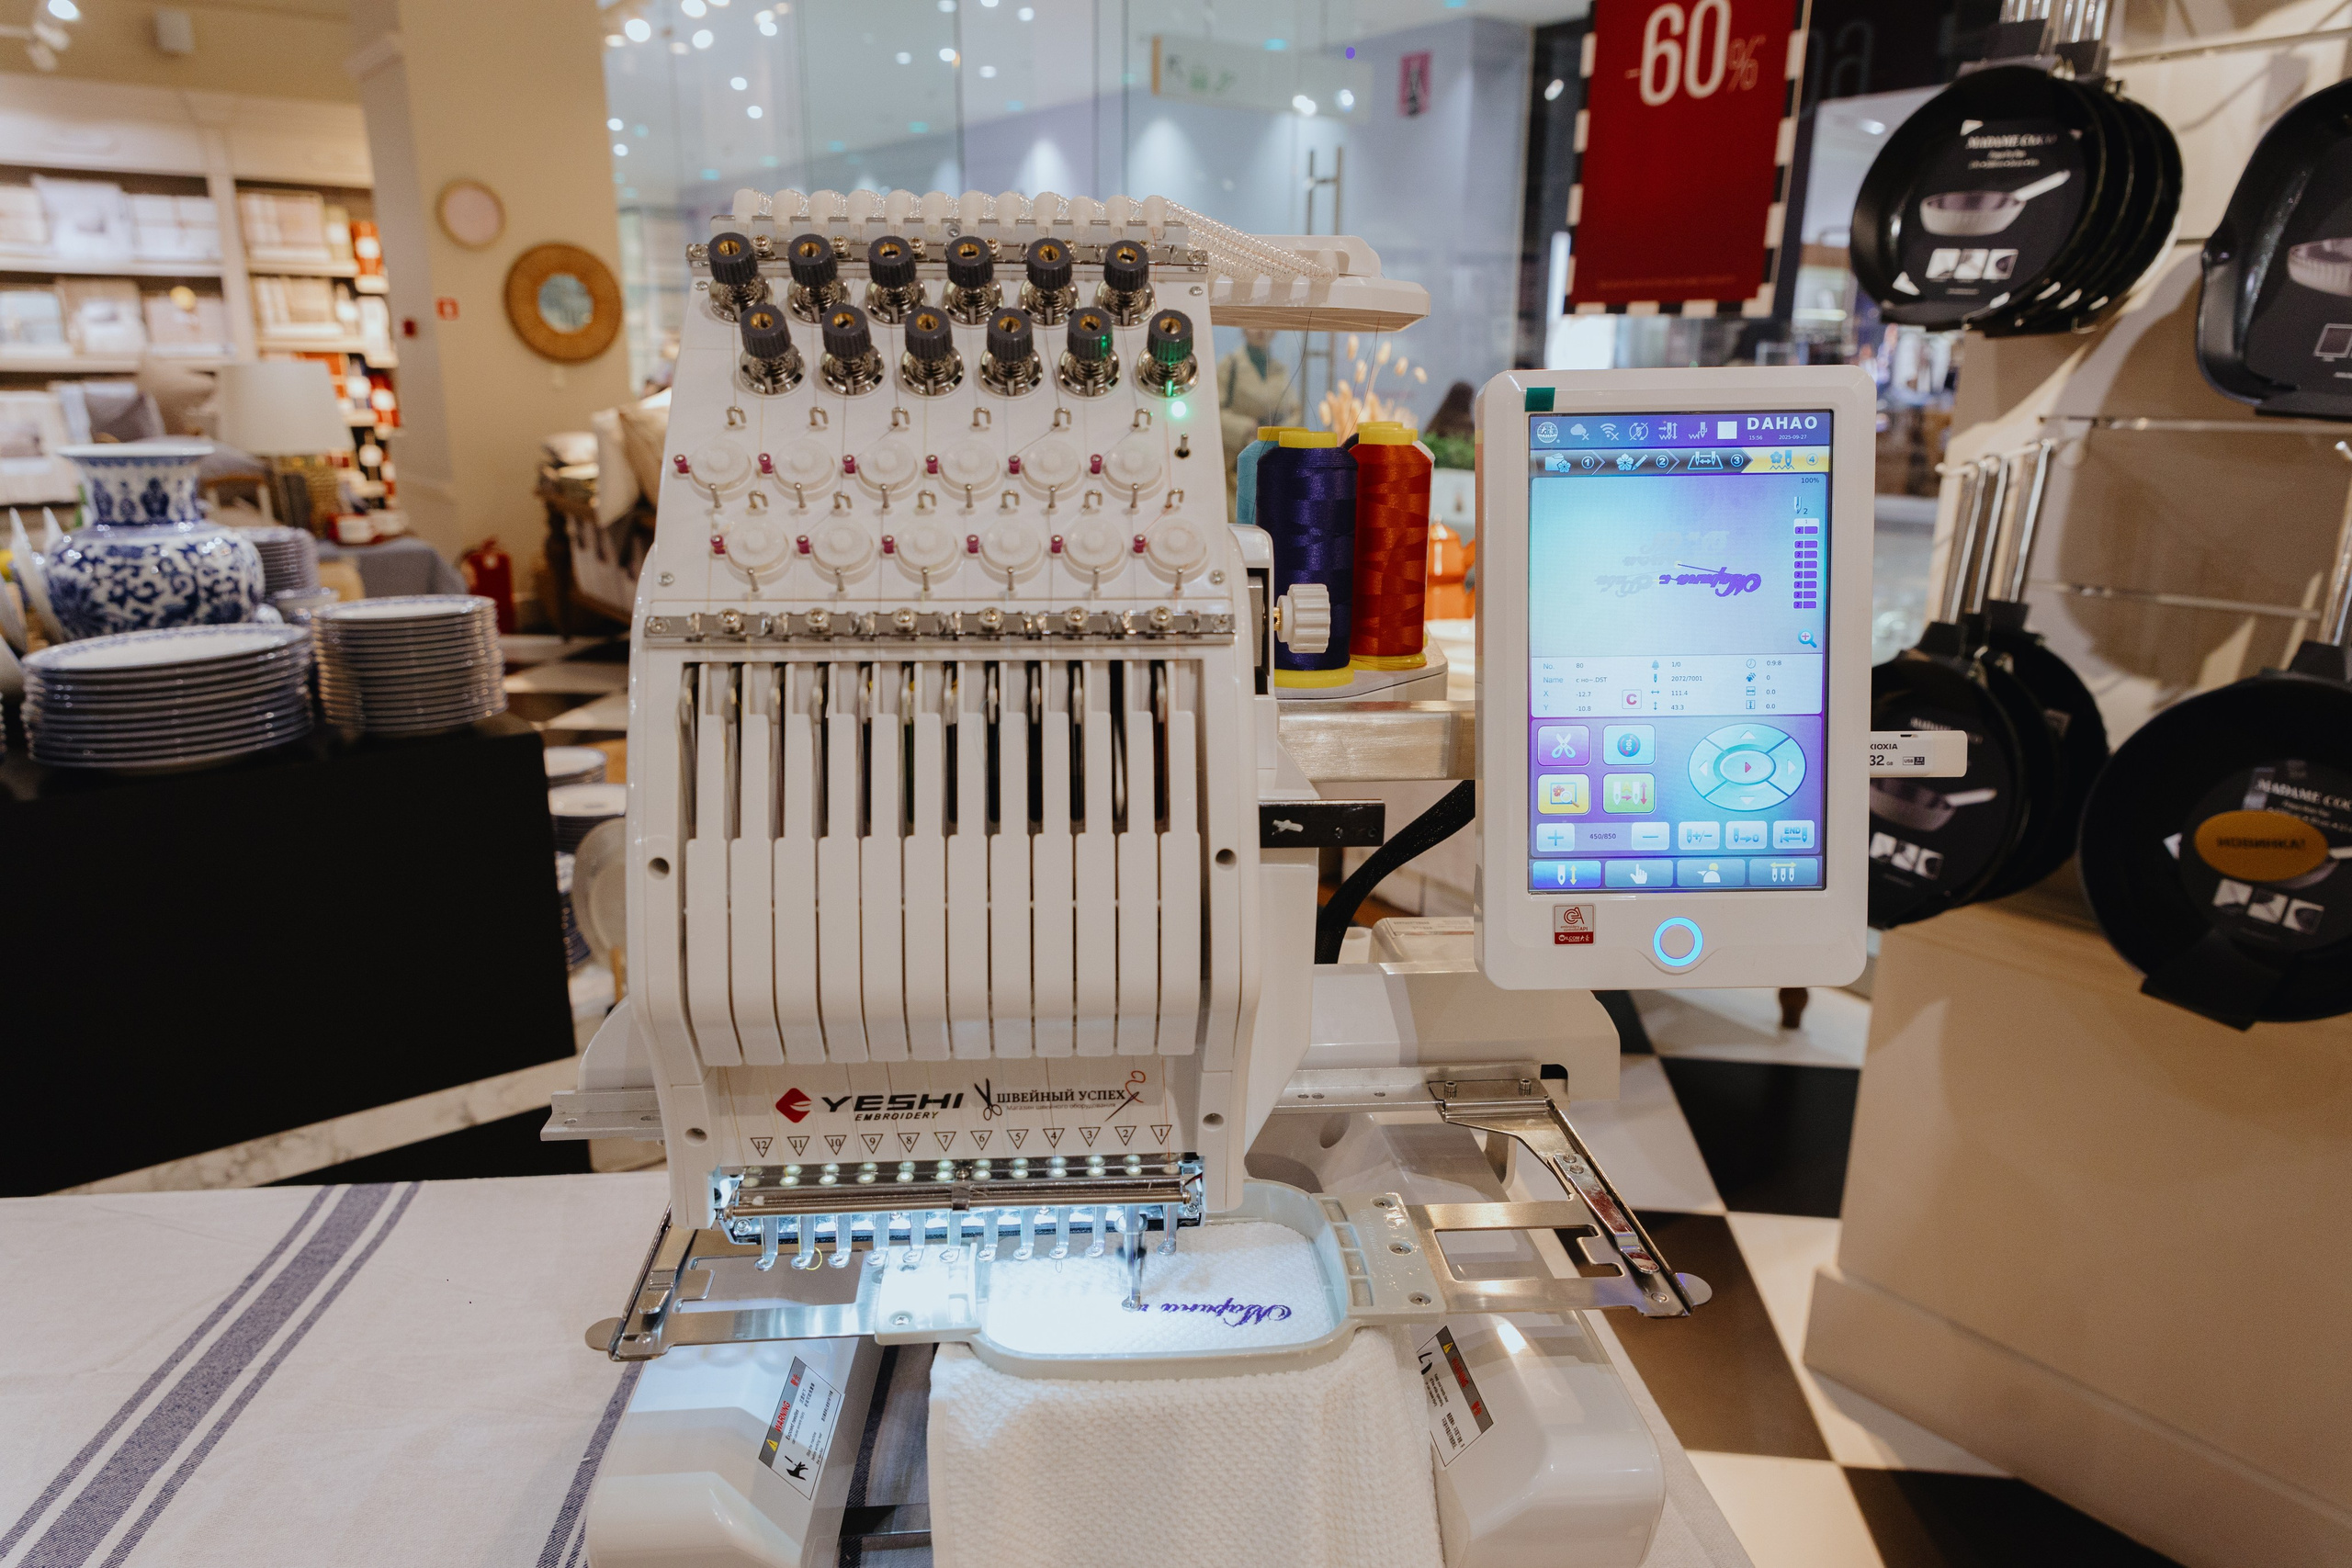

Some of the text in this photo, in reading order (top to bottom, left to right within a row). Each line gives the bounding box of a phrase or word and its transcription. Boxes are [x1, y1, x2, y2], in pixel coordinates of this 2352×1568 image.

[1747, 416, 1818, 430] DAHAO
[1626, 694, 1637, 705] C
[1870, 754, 1884, 766] 32
[1589, 832, 1617, 840] 450/850
[1784, 827, 1801, 835] END
[997, 1089, 1126, 1103] ШВЕЙНЫЙ УСПЕХ
[821, 1093, 964, 1112] YESHI
[854, 1111, 939, 1122] EMBROIDERY
[757, 1140, 768, 1149] 12
[794, 1139, 803, 1148] 11
[831, 1138, 842, 1147] 10
[1451, 1356, 1469, 1388] WARNING
[774, 1400, 791, 1433] WARNING
